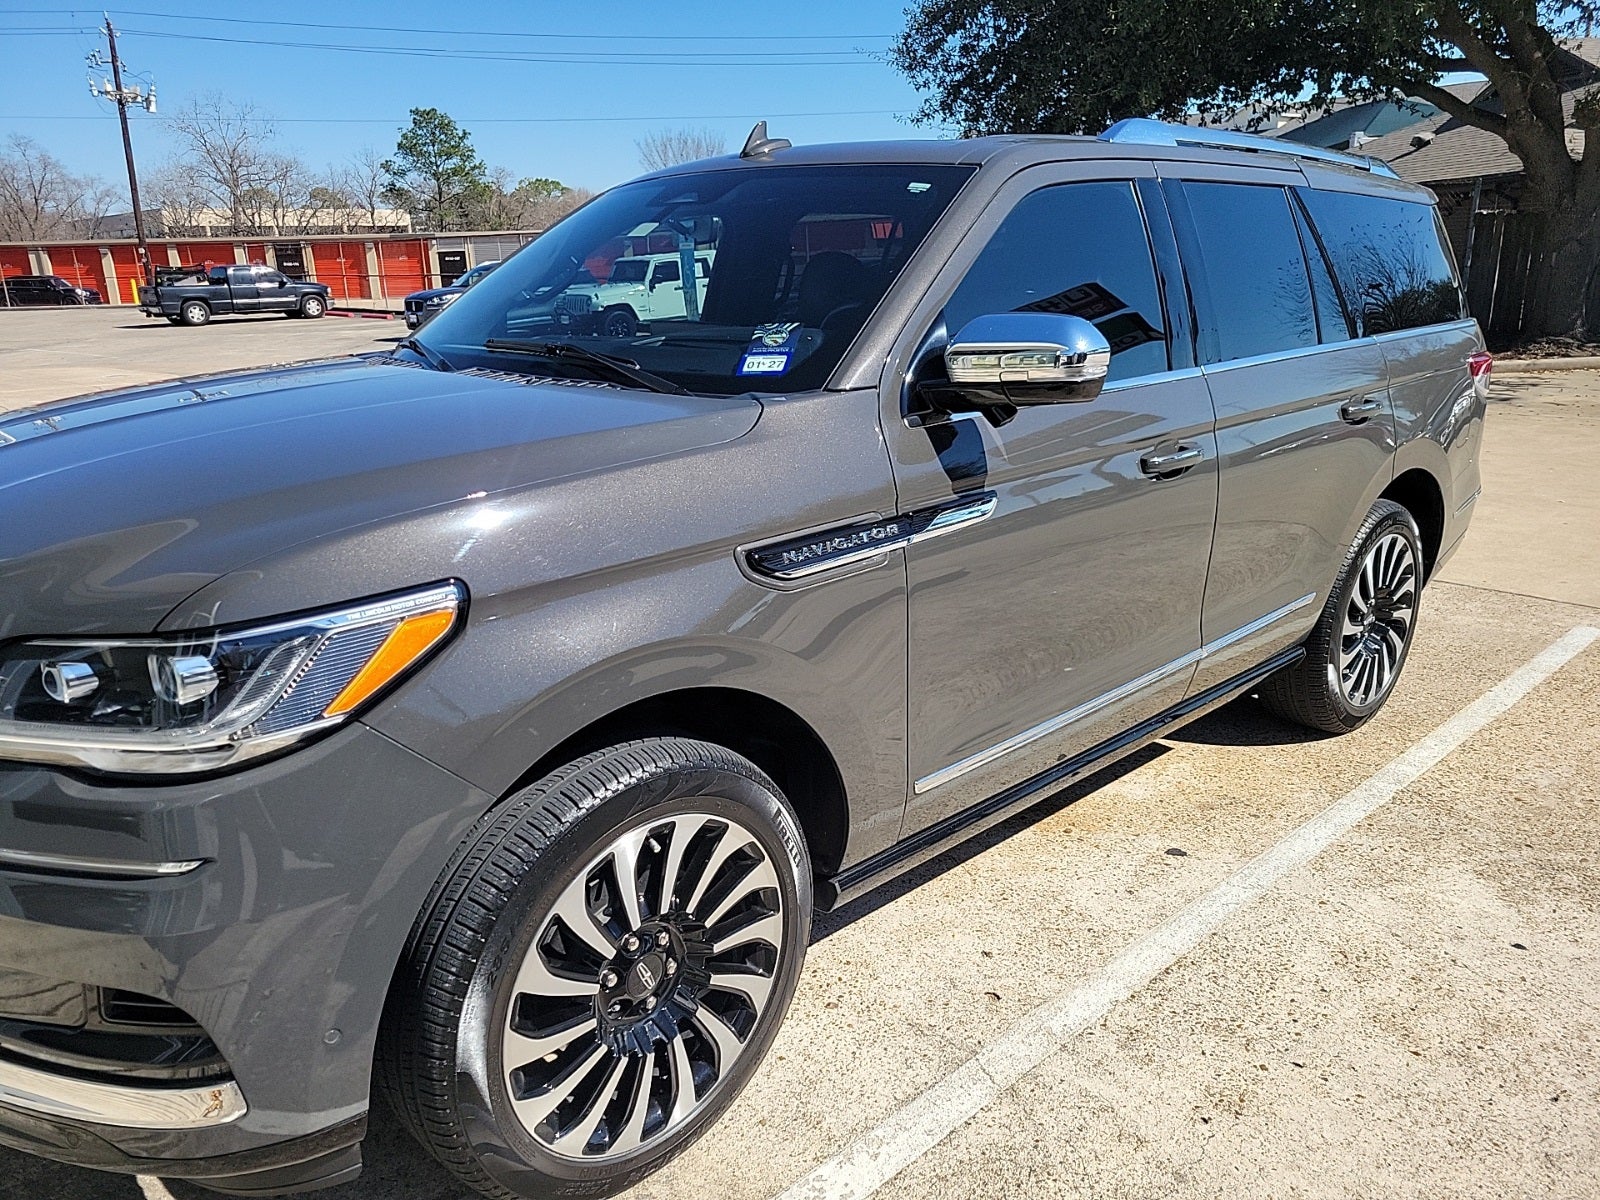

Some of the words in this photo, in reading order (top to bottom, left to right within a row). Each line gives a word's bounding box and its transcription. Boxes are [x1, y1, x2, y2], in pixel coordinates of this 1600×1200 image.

[747, 361, 761, 369] 01
[768, 361, 784, 369] 27
[782, 523, 899, 565] NAVIGATOR
[771, 806, 803, 868] PIRELLI
